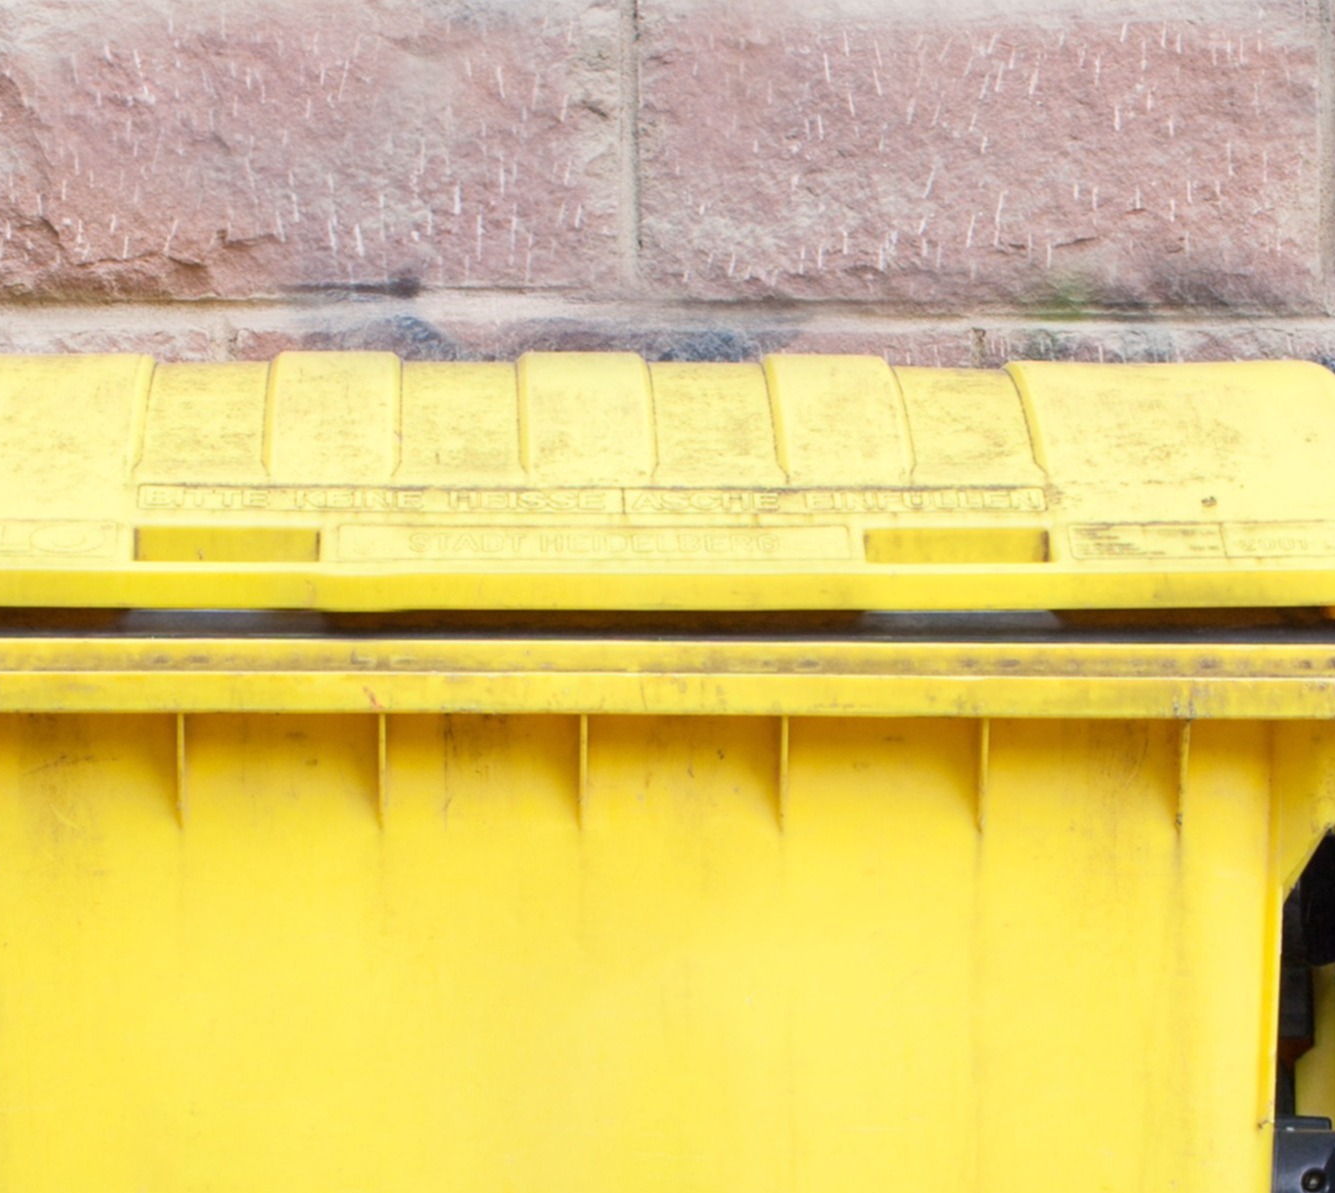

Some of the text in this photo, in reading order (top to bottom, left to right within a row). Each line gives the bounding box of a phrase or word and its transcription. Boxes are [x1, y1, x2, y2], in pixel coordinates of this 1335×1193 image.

[143, 487, 1042, 511] BITTE KEINE HEISSE ASCHE EINFÜLLEN
[408, 532, 780, 554] STADT HEIDELBERG
